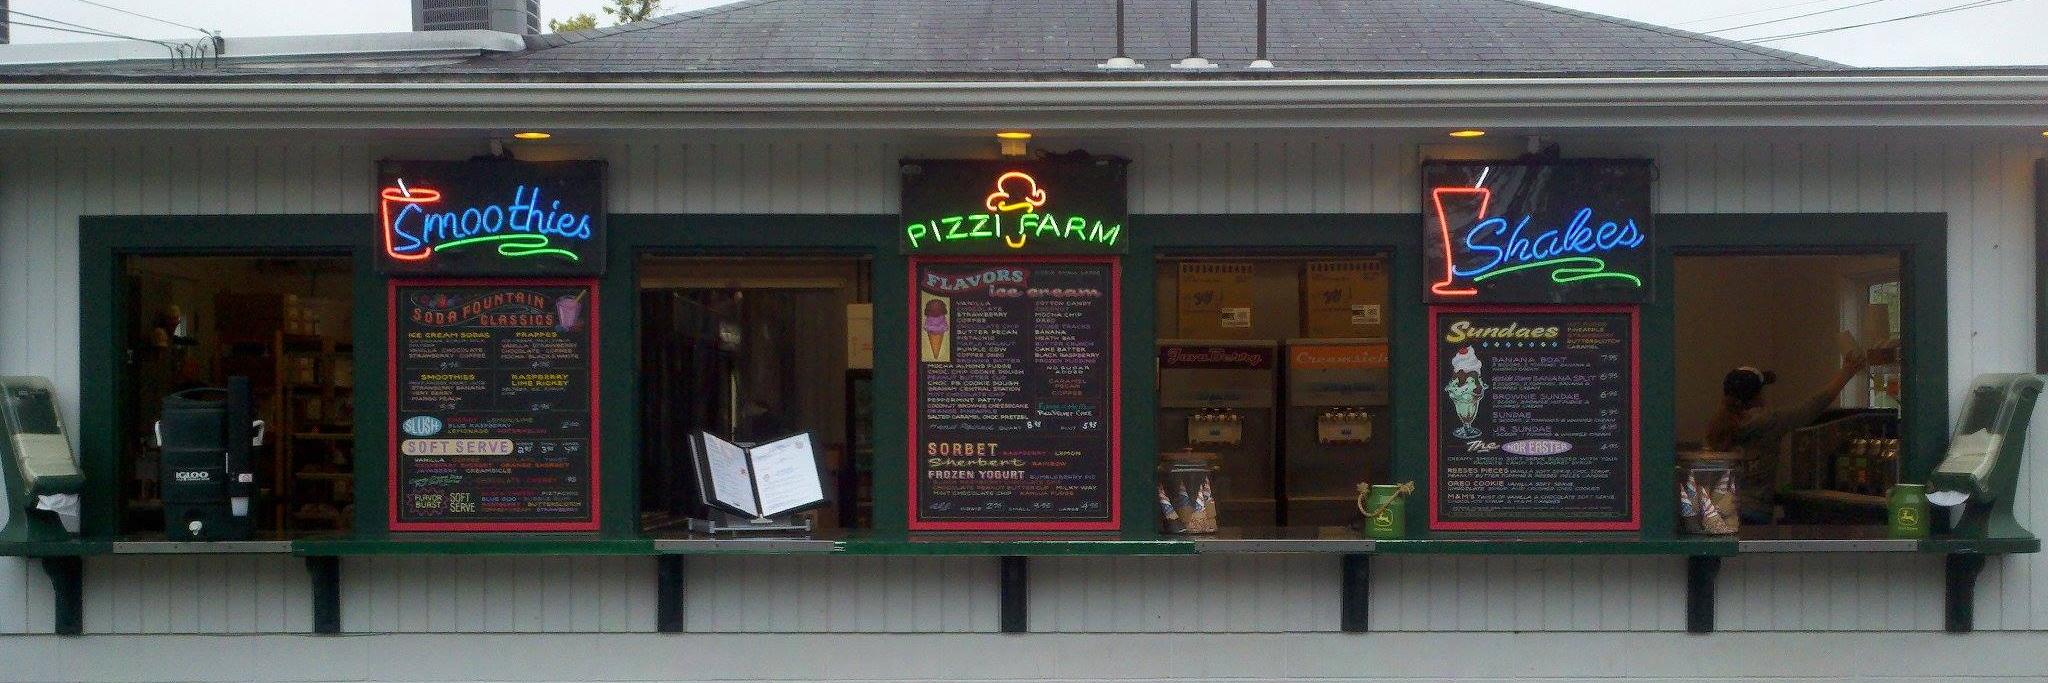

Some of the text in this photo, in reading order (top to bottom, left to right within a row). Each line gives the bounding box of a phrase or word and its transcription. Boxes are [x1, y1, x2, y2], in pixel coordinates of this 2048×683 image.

[394, 184, 591, 251] Smoothies
[907, 213, 1121, 248] PIZZI FARM
[1451, 207, 1645, 276] Shakes
[927, 269, 1024, 291] FLAVORS
[988, 284, 1101, 298] ice cream
[411, 291, 546, 326] SODA FOUNTAIN
[479, 313, 555, 327] CLASSICS
[407, 332, 491, 340] ICE CREAM SODAS
[1446, 320, 1560, 343] Sundaes
[420, 374, 477, 382] SMOOTHIES
[511, 373, 570, 381] RASPBERRY
[1492, 411, 1532, 419] SUNDAE
[402, 416, 443, 436] SLUSH
[1513, 425, 1552, 433] SUNDAE
[408, 442, 450, 454] SOFT
[455, 442, 509, 454] SERVE
[927, 442, 999, 456] SORBET
[1467, 440, 1500, 453] The
[928, 457, 1025, 468] Sherbert
[176, 471, 209, 480] IGLOO
[927, 470, 975, 480] FROZEN
[979, 470, 1026, 480] YOGURT
[449, 492, 471, 502] SOFT
[415, 501, 441, 509] BURST
[449, 502, 476, 513] SERVE
